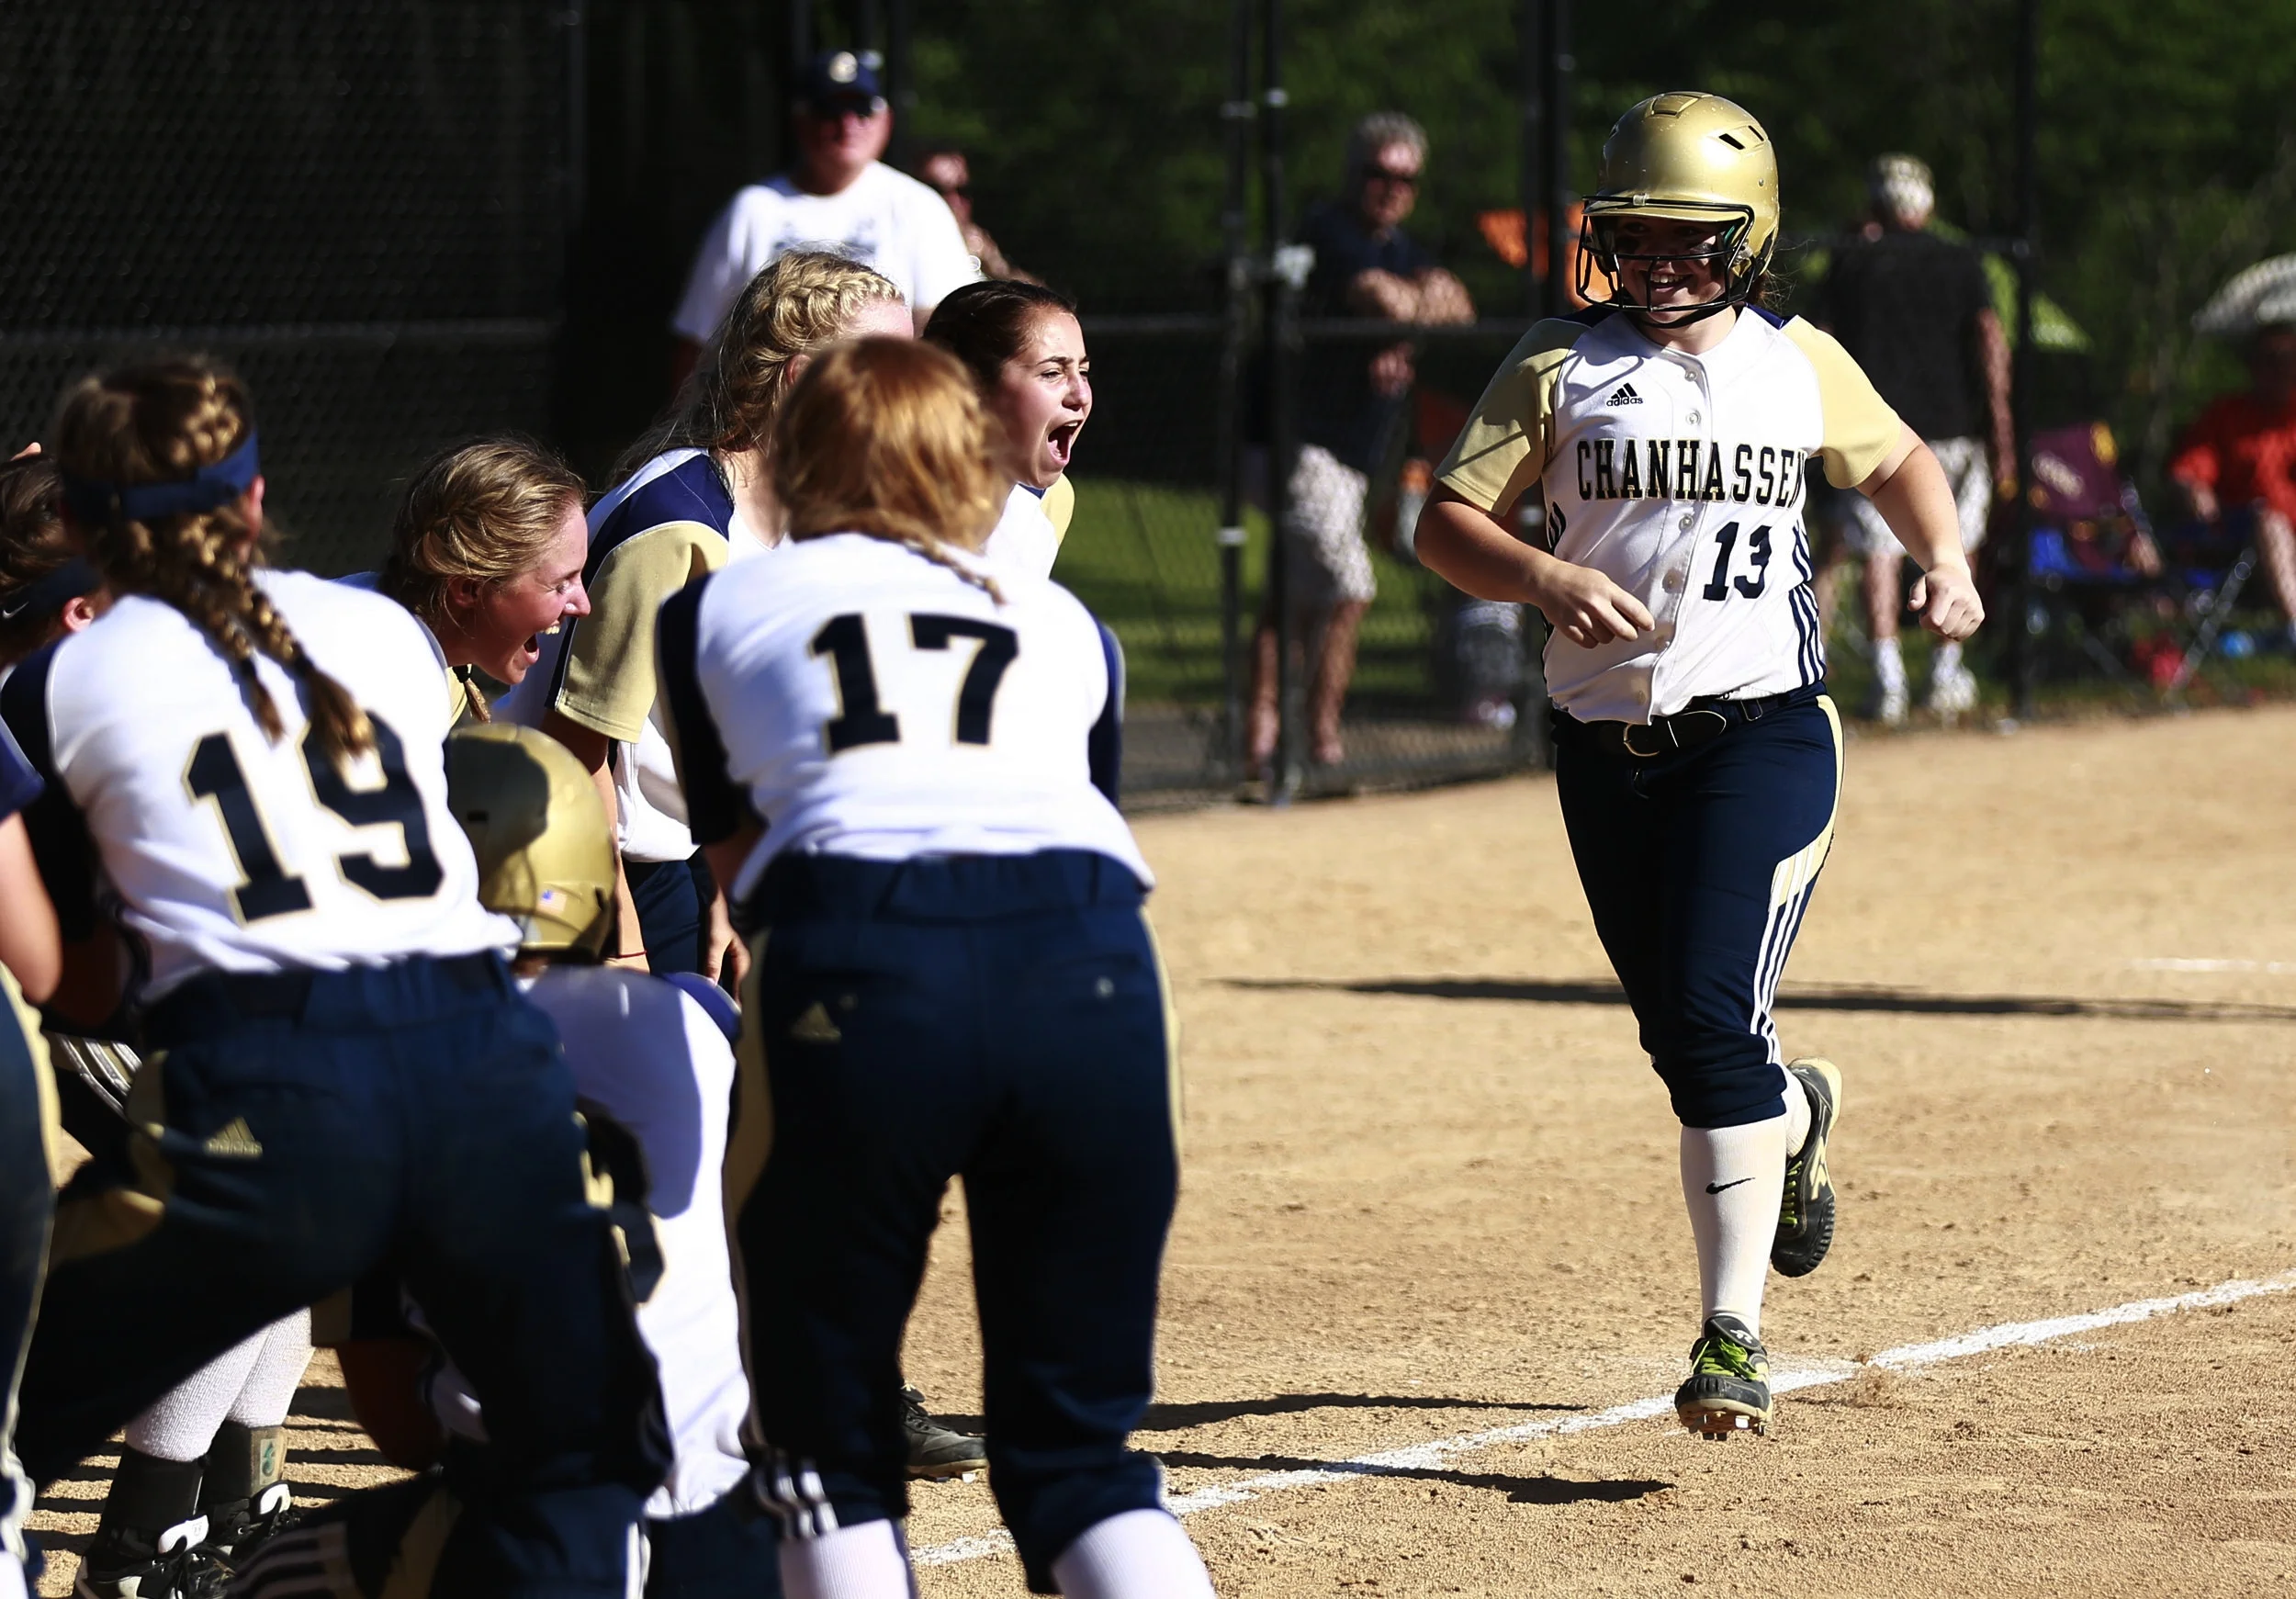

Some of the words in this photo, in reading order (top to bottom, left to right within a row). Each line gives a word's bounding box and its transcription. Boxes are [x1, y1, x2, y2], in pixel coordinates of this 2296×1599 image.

[1606, 395, 1643, 406] adidas
[1703, 521, 1772, 602] 13
[807, 613, 1019, 755] 17
[184, 711, 445, 924] 19
